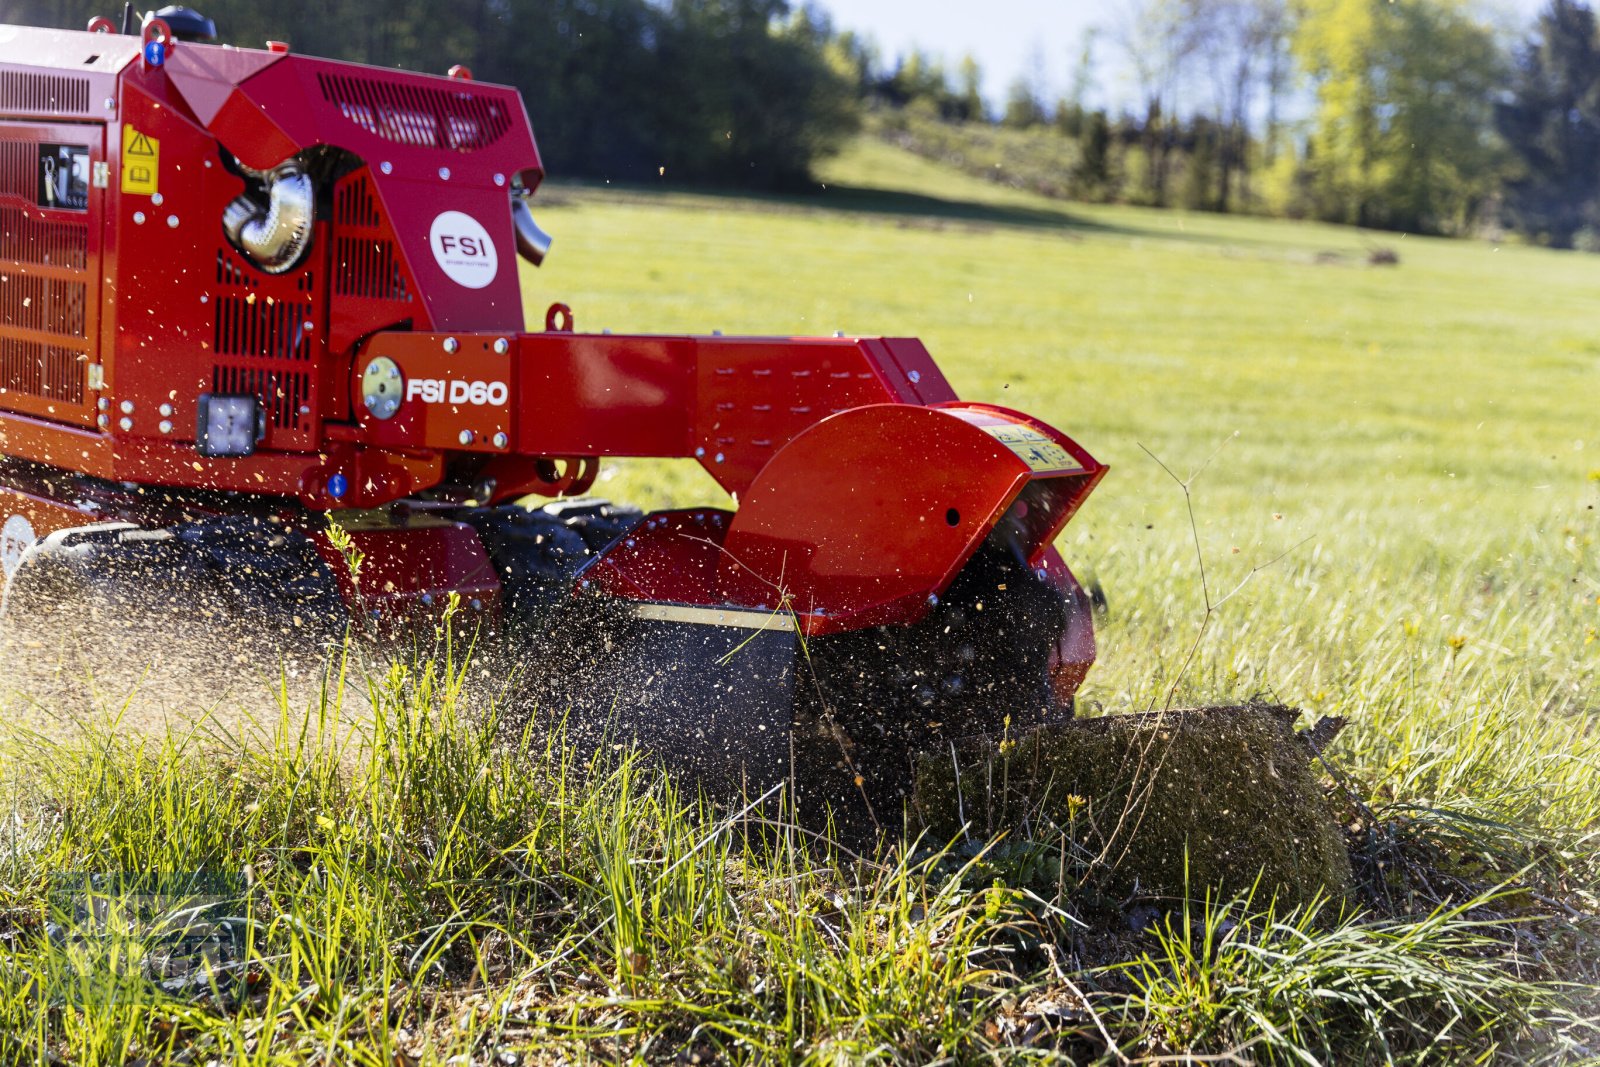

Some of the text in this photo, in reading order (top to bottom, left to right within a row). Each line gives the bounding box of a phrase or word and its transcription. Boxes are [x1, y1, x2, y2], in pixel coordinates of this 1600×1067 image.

[440, 235, 487, 257] FSI
[406, 378, 509, 406] FSI D60
[6, 536, 28, 556] FS
